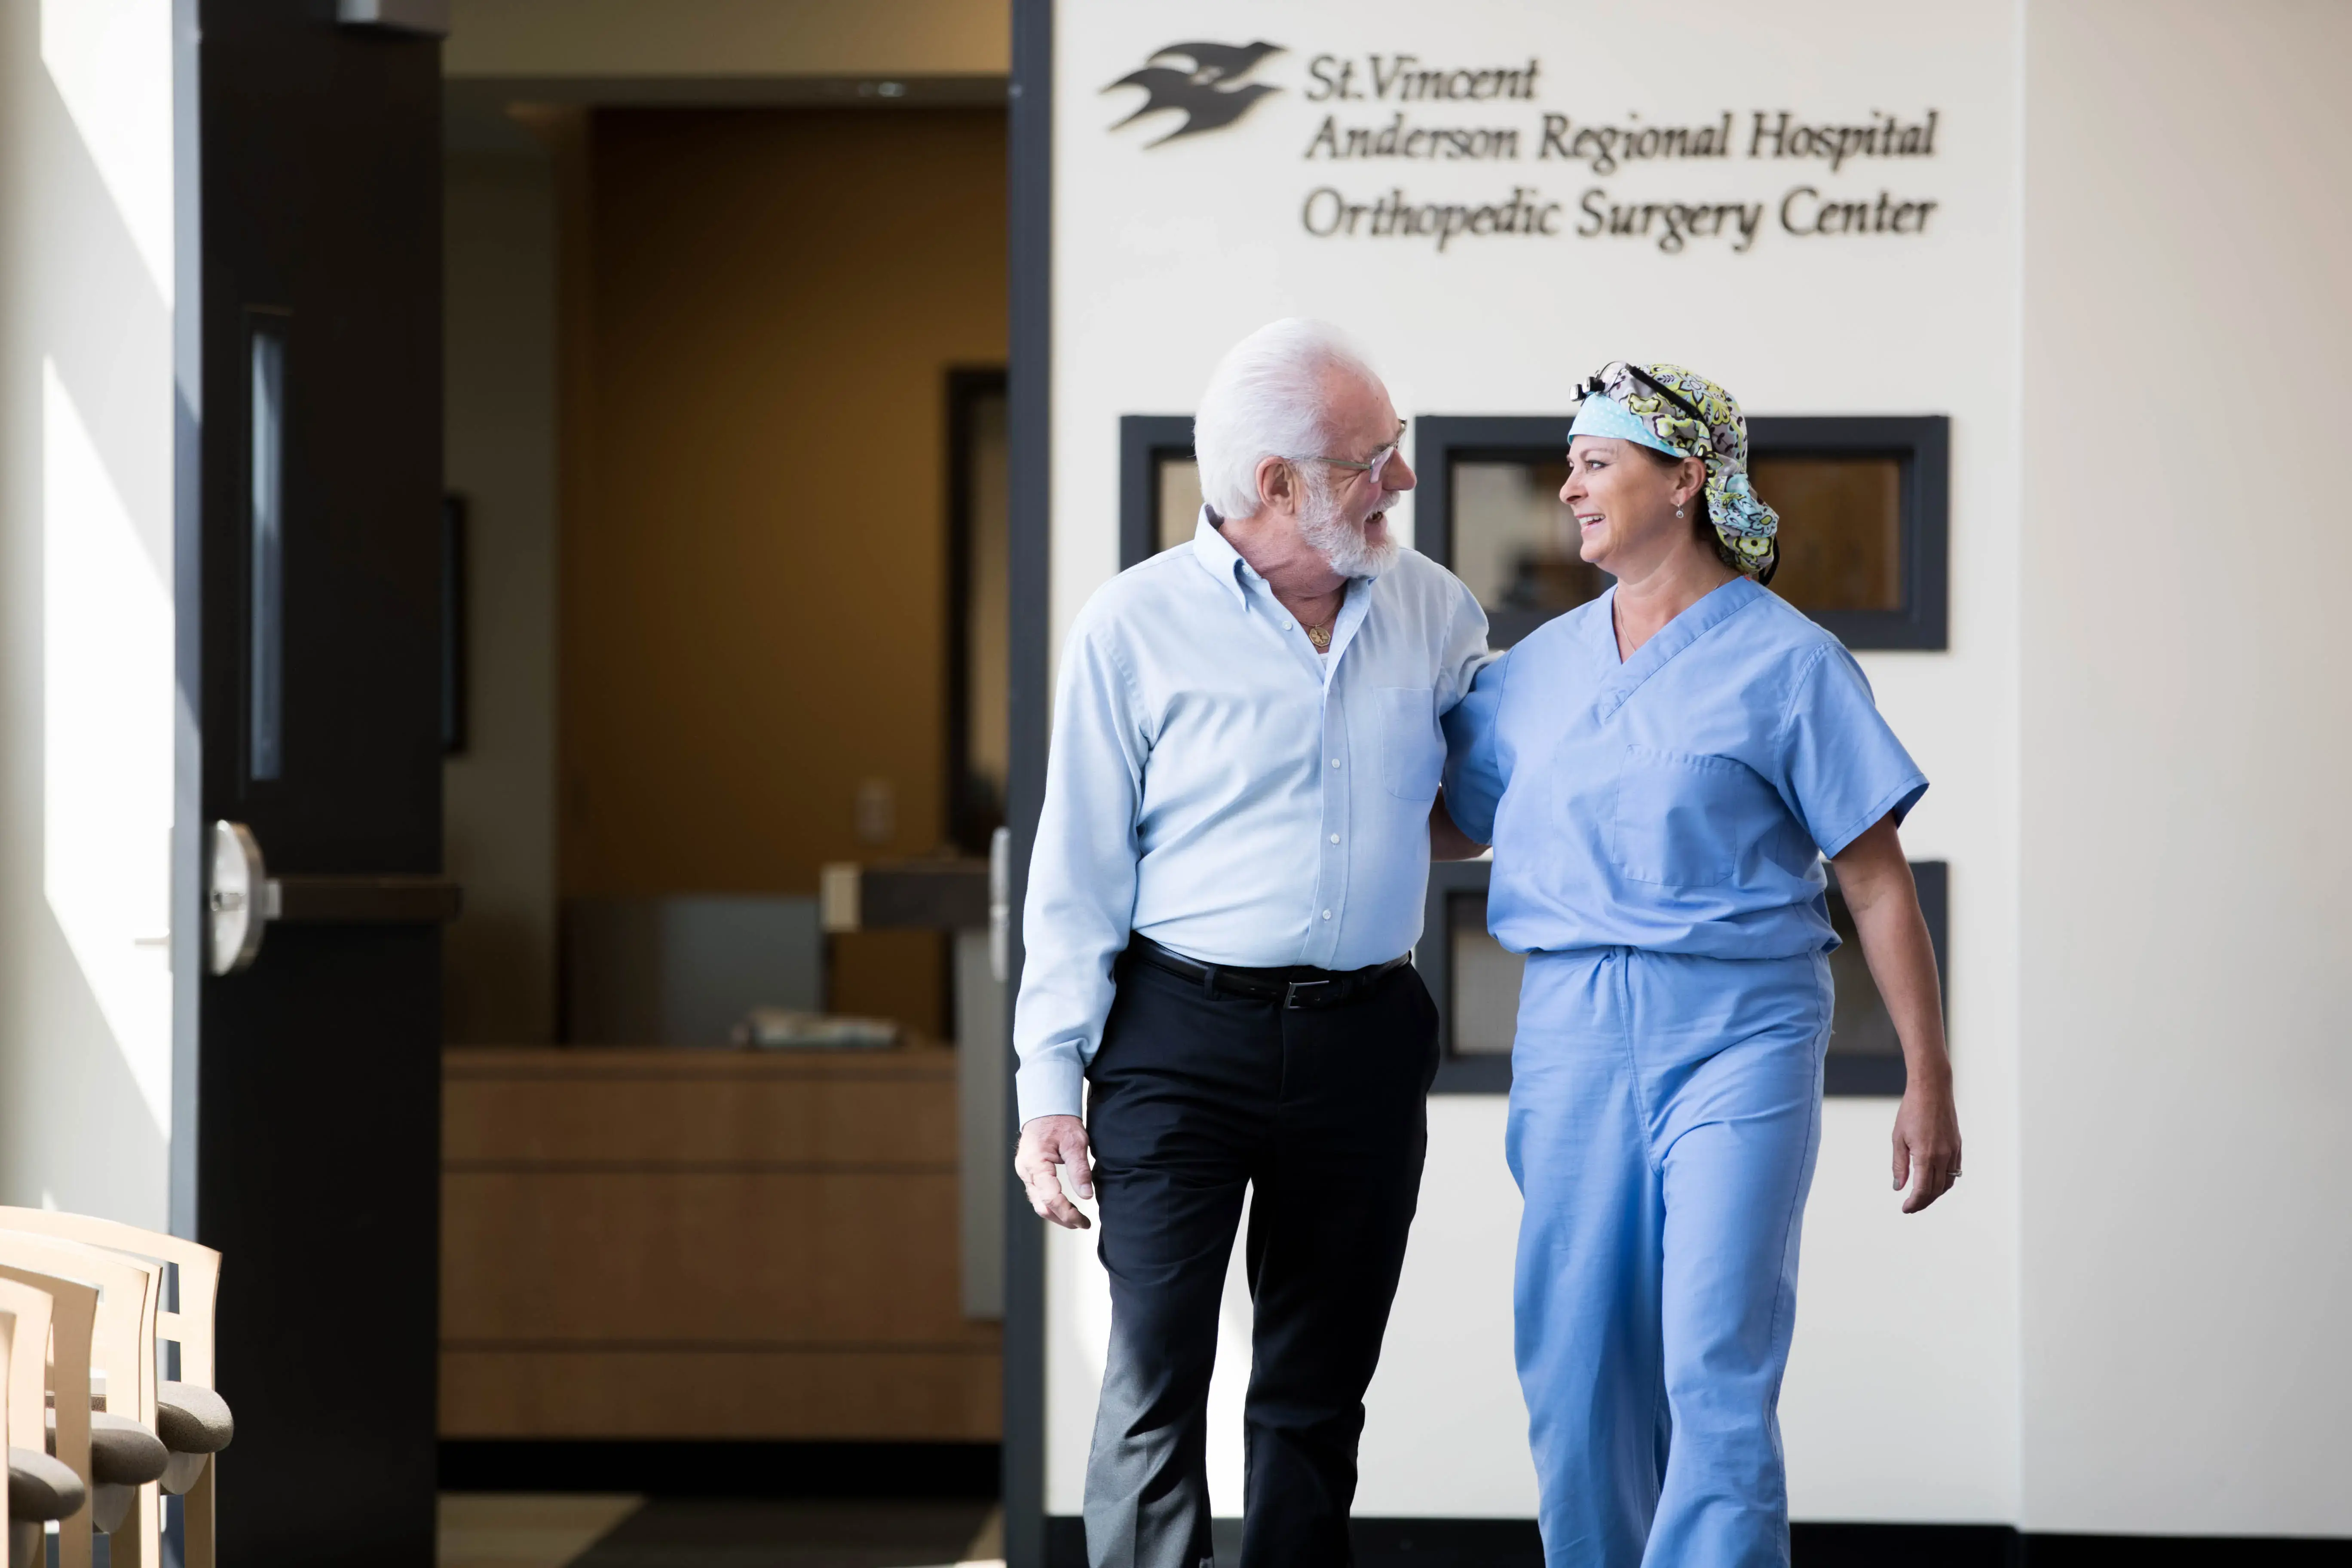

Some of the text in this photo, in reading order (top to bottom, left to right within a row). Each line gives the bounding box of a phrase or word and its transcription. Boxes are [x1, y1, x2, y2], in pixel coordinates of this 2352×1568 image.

[1305, 112, 1939, 172] Anderson Regional Hospital
[1302, 187, 1939, 252] Orthopedic Surgery Center
